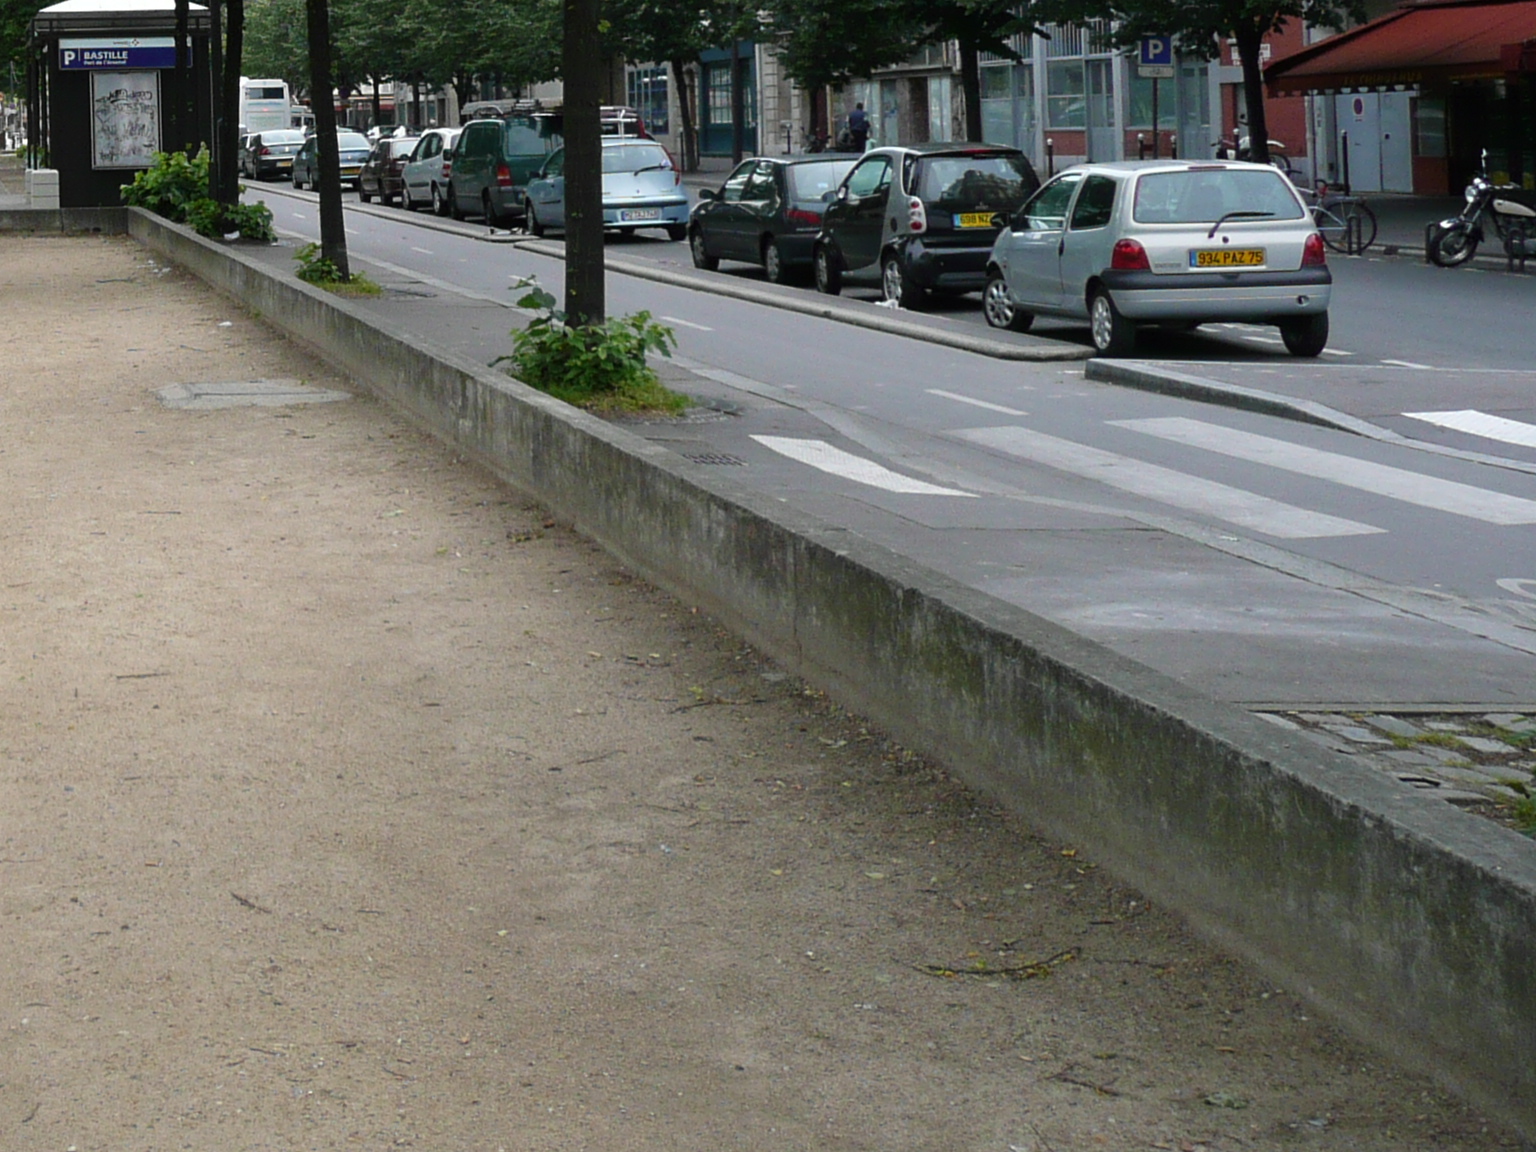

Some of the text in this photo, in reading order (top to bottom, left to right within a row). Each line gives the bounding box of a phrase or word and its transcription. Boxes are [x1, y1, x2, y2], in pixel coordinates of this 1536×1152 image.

[1148, 39, 1164, 59] P
[64, 51, 128, 65] P BASTILLE
[1198, 251, 1264, 264] 934 PAZ 75
